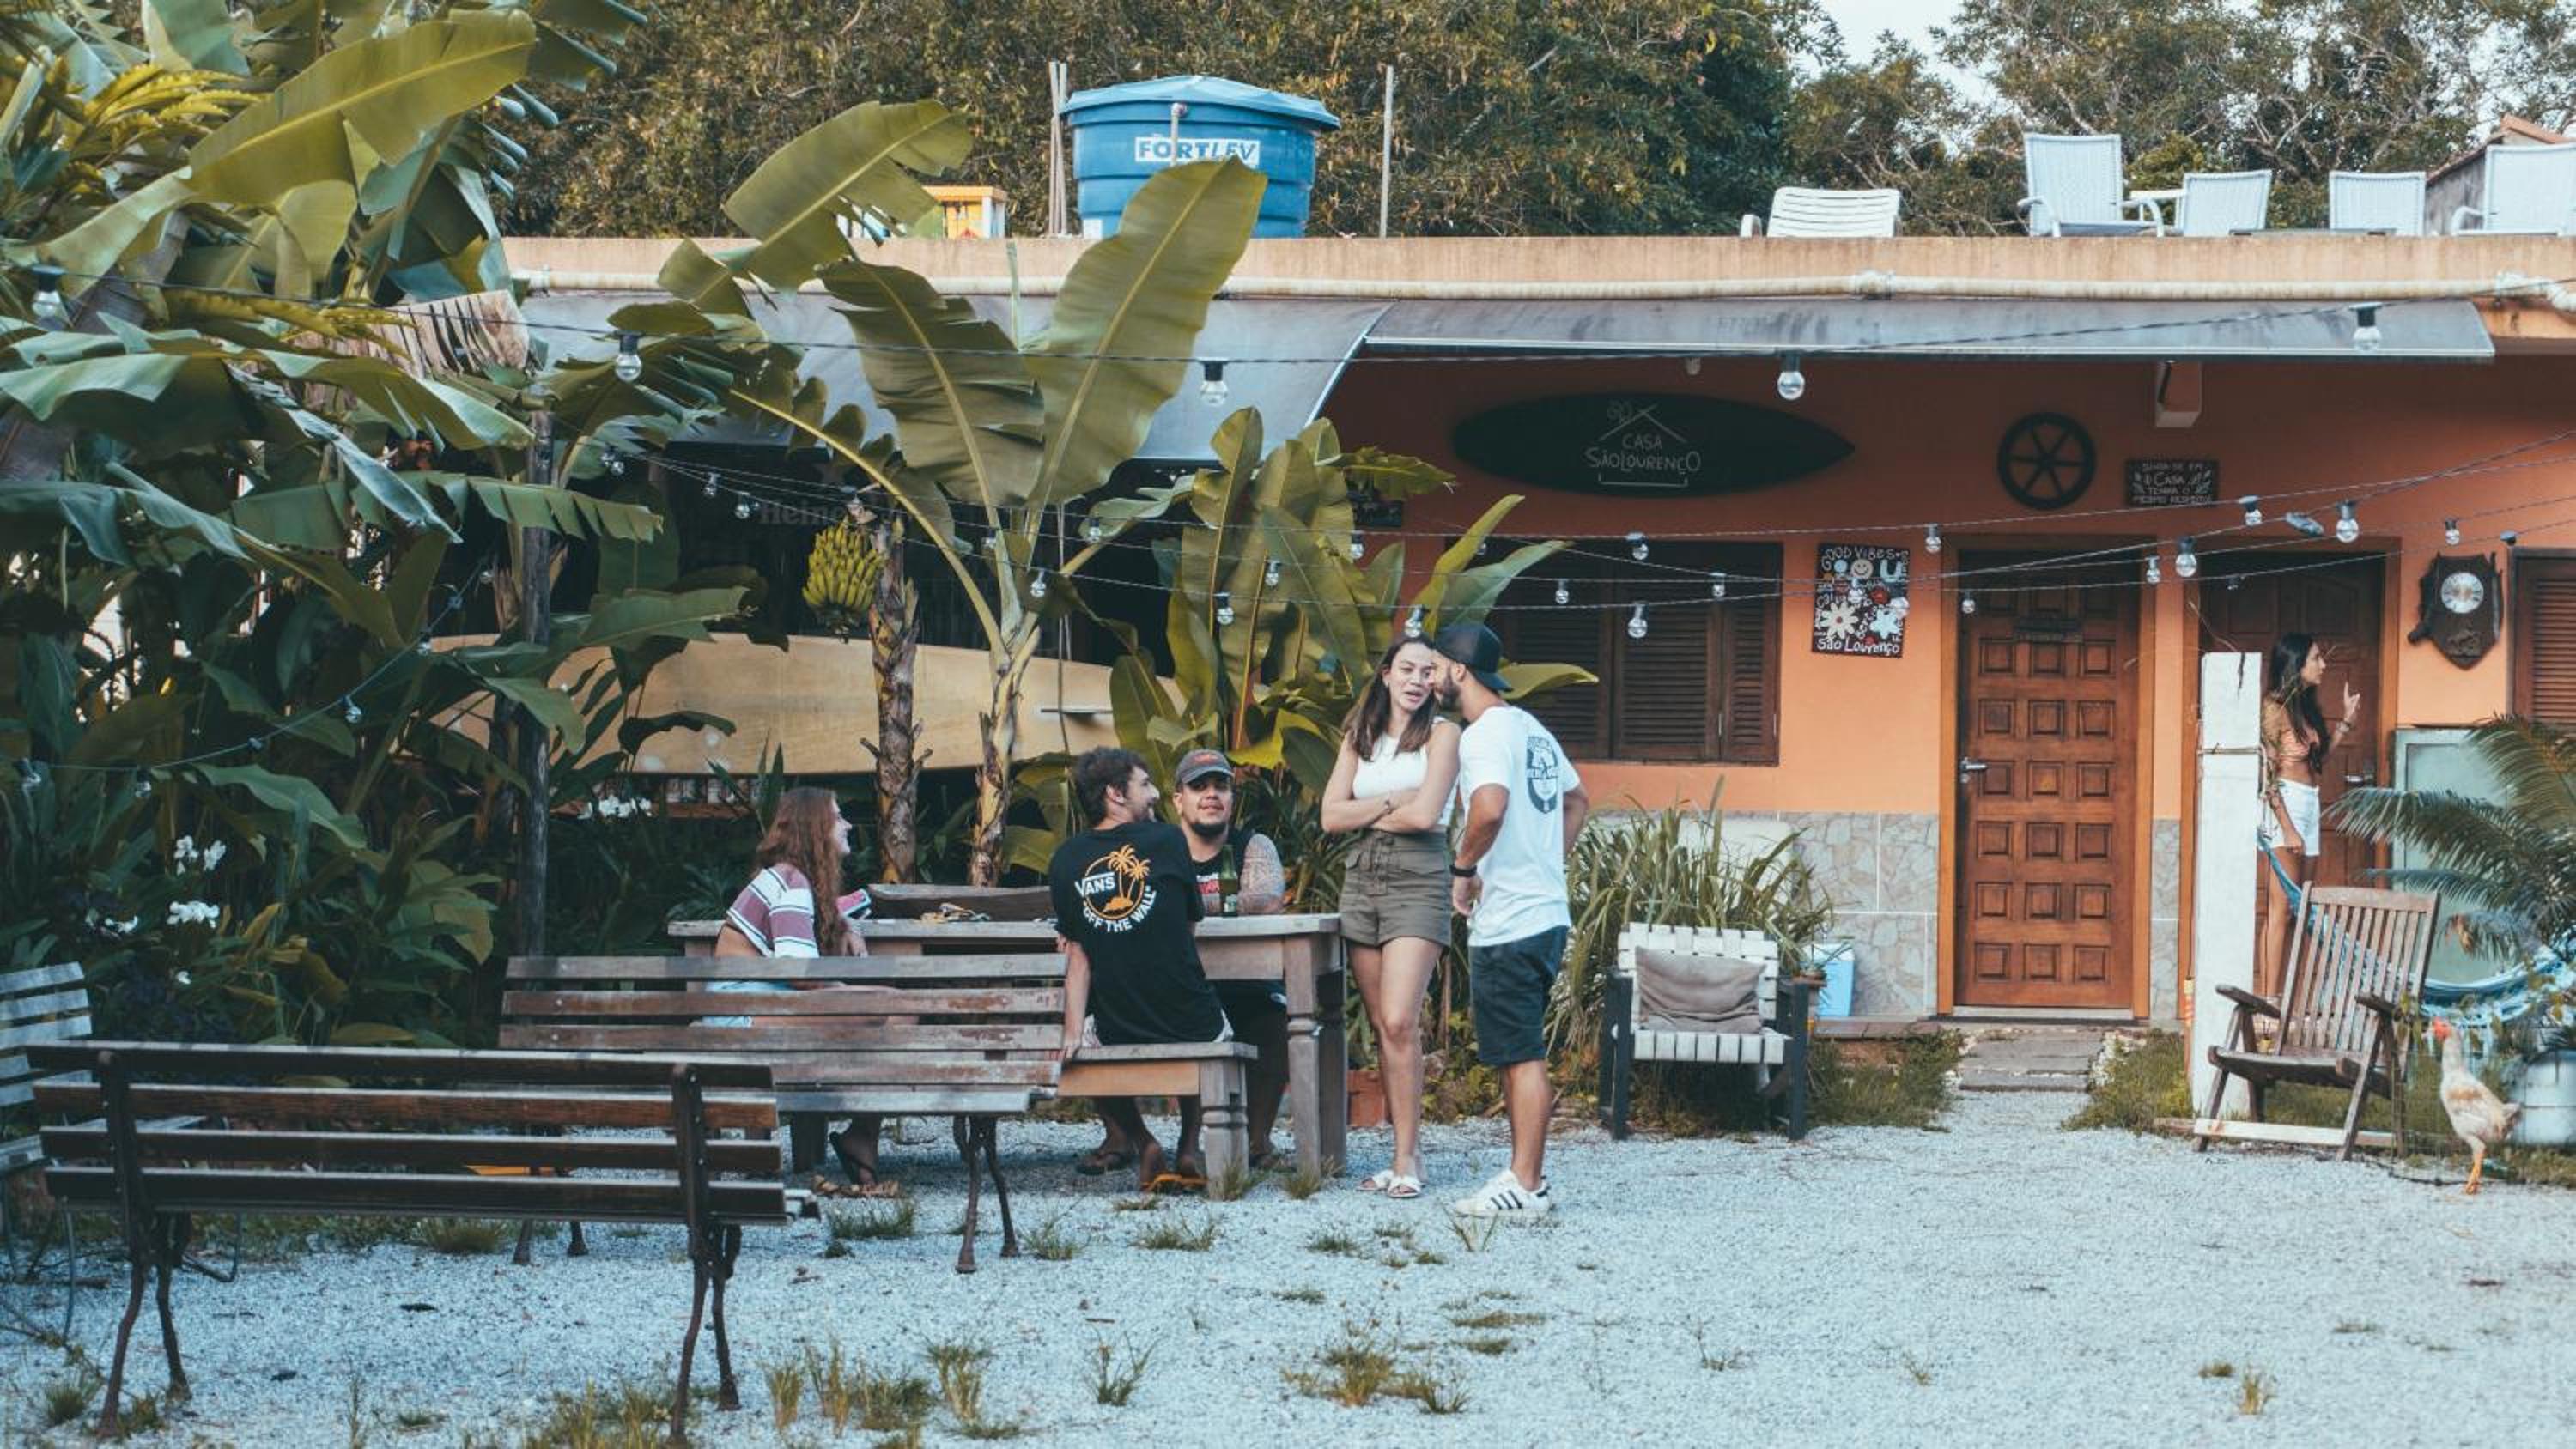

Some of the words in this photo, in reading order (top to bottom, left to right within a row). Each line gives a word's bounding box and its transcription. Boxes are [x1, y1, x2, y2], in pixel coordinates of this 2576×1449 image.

[1139, 141, 1256, 160] FORTLEV
[1621, 433, 1663, 450] CASA
[1074, 871, 1115, 898] VANS
[1105, 919, 1133, 933] THE
